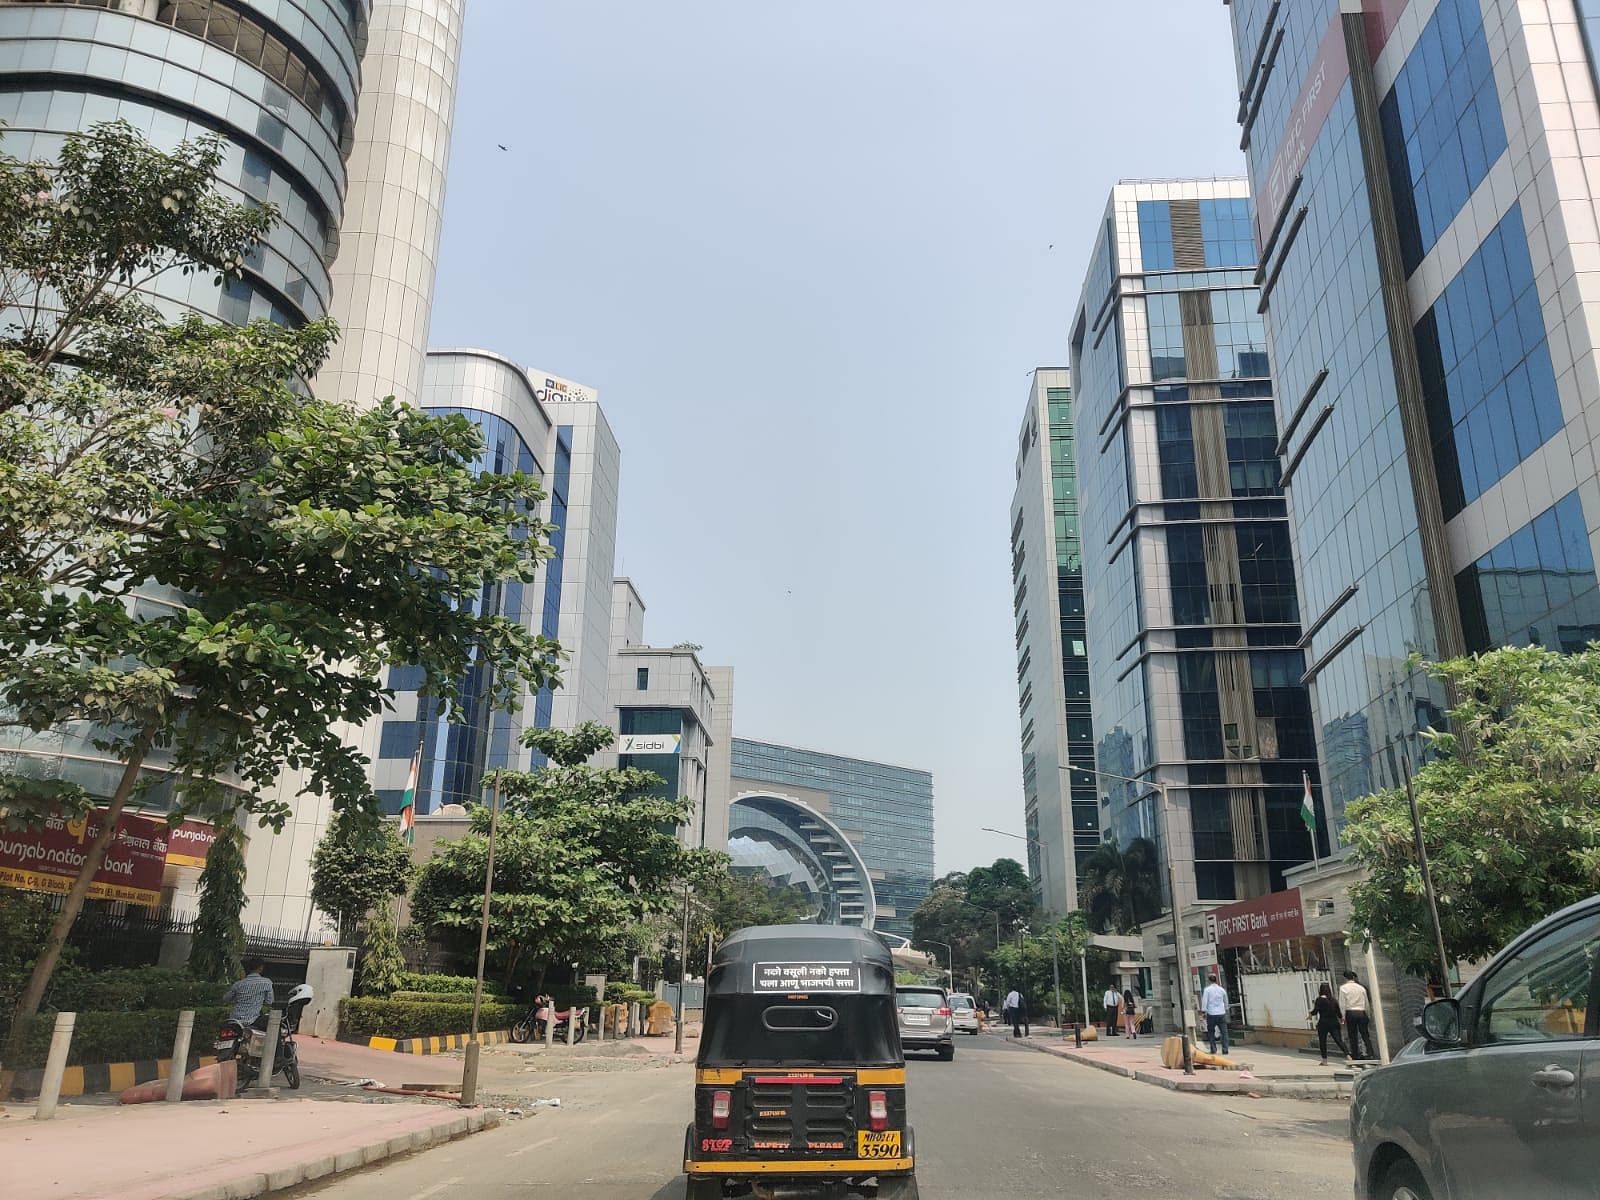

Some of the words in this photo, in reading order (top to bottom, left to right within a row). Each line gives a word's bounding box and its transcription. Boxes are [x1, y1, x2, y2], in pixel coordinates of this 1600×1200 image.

[1302, 61, 1326, 123] FIRST
[635, 740, 665, 750] sidbi
[171, 829, 207, 843] punjab
[104, 855, 135, 875] bank
[1232, 914, 1250, 934] FIRST
[1250, 911, 1269, 930] Bank
[860, 1143, 900, 1158] 3590
